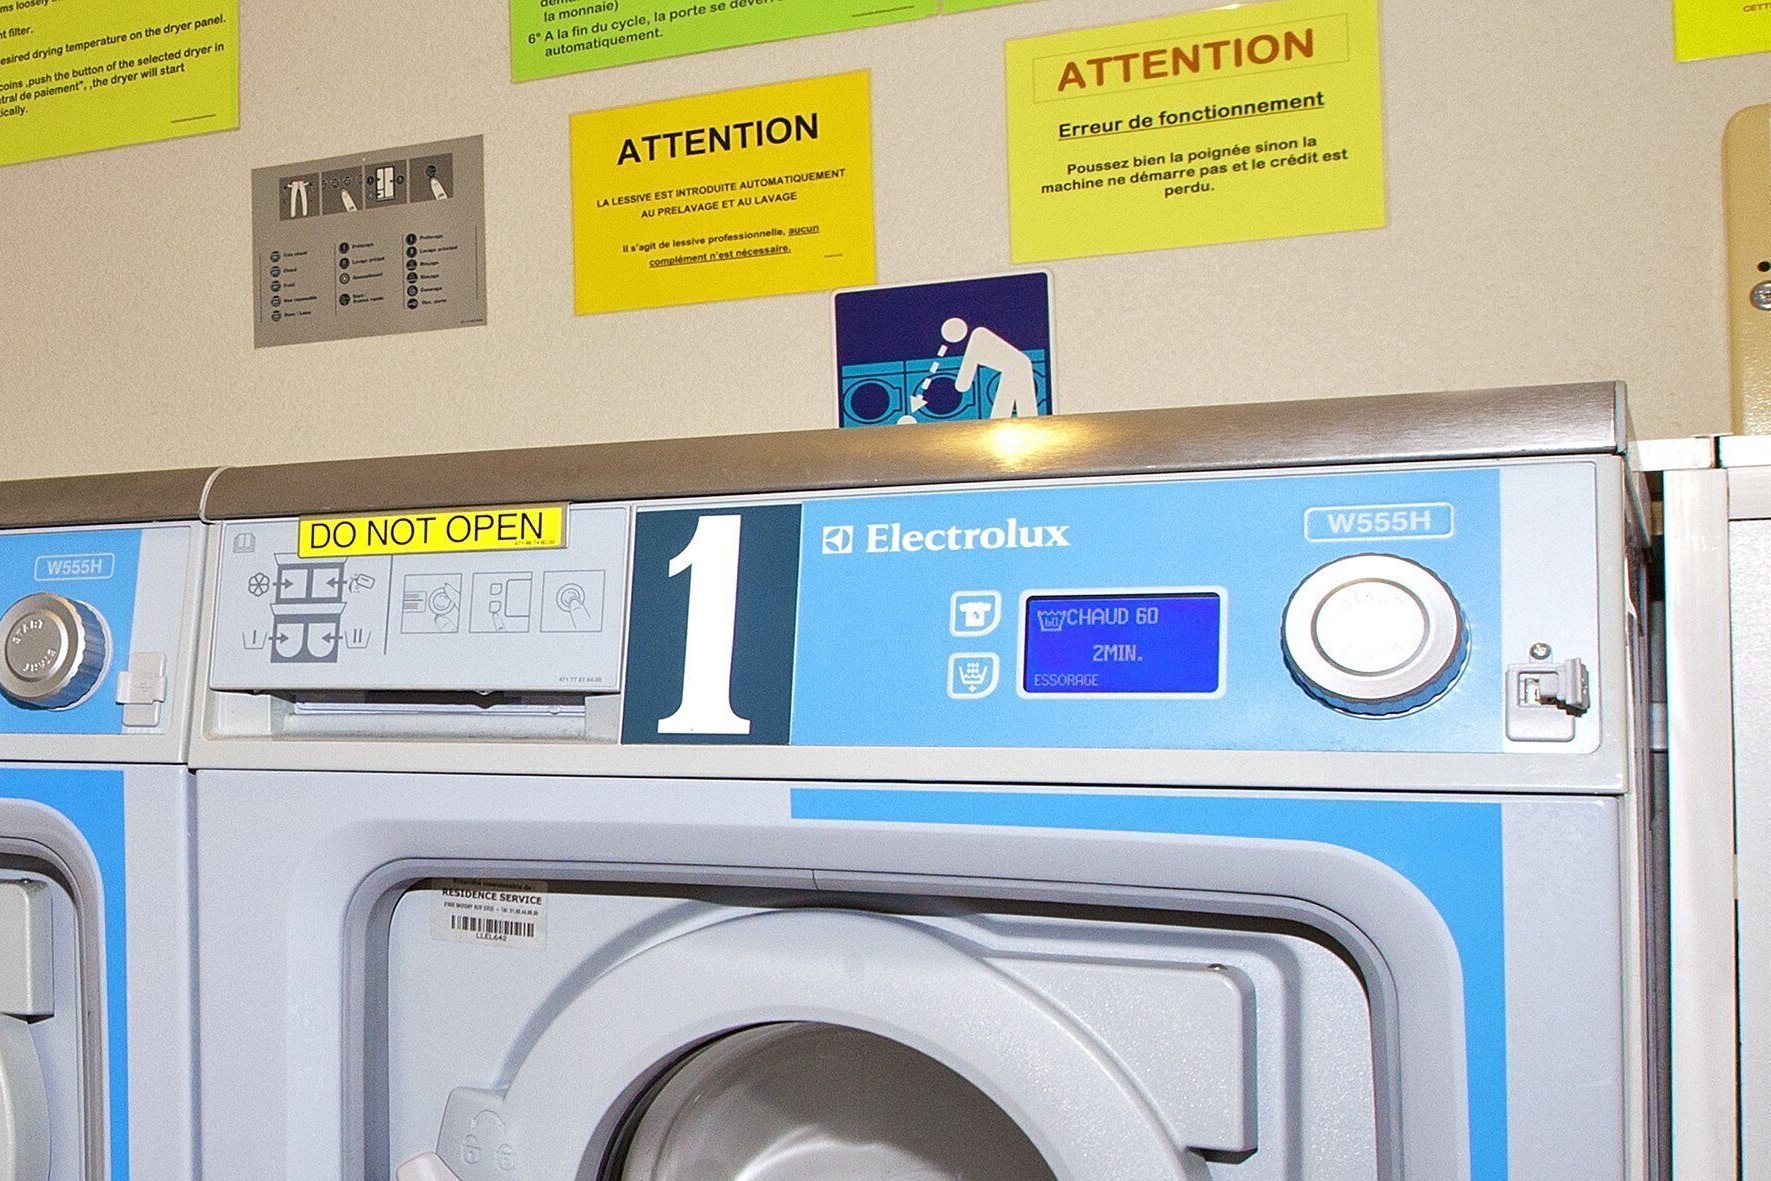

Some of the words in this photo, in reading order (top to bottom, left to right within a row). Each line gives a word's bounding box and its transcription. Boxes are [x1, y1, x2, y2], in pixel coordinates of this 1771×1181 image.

[544, 12, 555, 22] la
[559, 1, 619, 20] monnaie)
[545, 32, 554, 41] A
[557, 30, 569, 39] la
[572, 26, 588, 36] fin
[592, 23, 608, 33] du
[611, 15, 650, 31] cycle,
[654, 12, 665, 22] la
[669, 5, 706, 22] porte
[710, 2, 726, 12] se
[8, 26, 33, 37] filter.
[32, 46, 63, 59] drying
[65, 34, 127, 52] temperature
[129, 31, 142, 40] on
[144, 27, 161, 37] the
[163, 21, 192, 34] dryer
[194, 13, 226, 30] panel.
[545, 28, 663, 57] automatiquement.
[25, 73, 52, 88] ,push
[53, 71, 69, 81] the
[71, 65, 103, 77] button
[105, 60, 116, 71] of
[118, 59, 134, 69] the
[137, 49, 181, 66] selected
[183, 45, 212, 58] dryer
[214, 42, 224, 51] in
[1057, 28, 1313, 92] ATTENTION
[19, 86, 31, 100] de
[33, 80, 86, 100] paiement",
[89, 77, 108, 90] ,the
[110, 72, 138, 85] dryer
[140, 67, 157, 78] will
[159, 62, 184, 75] start
[1059, 120, 1123, 138] Erreur
[1128, 114, 1152, 129] de
[1158, 91, 1324, 125] fonctionnement
[617, 112, 817, 165] ATTENTION
[1041, 178, 1103, 193] machine
[1107, 176, 1125, 186] ne
[1129, 168, 1195, 183] démarre
[1199, 164, 1227, 178] pas
[1232, 160, 1248, 172] et
[1251, 158, 1265, 170] le
[1269, 152, 1318, 167] crédit
[1322, 148, 1348, 161] est
[1067, 159, 1129, 175] Poussez
[1133, 155, 1165, 167] bien
[1170, 152, 1183, 163] la
[1188, 144, 1250, 163] poignée
[1255, 140, 1298, 153] sinon
[1302, 136, 1316, 147] la
[596, 198, 609, 207] LA
[611, 192, 651, 205] LESSIVE
[654, 189, 673, 200] EST
[675, 182, 736, 197] INTRODUITE
[739, 168, 845, 189] AUTOMATIQUEMENT
[1164, 182, 1214, 198] perdu.
[640, 209, 655, 218] AU
[657, 201, 718, 216] PRELAVAGE
[721, 199, 734, 208] ET
[737, 197, 751, 206] AU
[754, 191, 796, 204] LAVAGE
[630, 242, 656, 252] s'agit
[658, 240, 670, 249] de
[672, 237, 705, 247] lessive
[707, 228, 785, 245] professionnelle,
[788, 225, 819, 235] aucun
[649, 253, 707, 267] complément
[736, 245, 790, 259] nécessaire.
[310, 519, 356, 549] DO
[367, 517, 436, 546] NOT
[447, 512, 544, 543] OPEN
[866, 518, 1071, 553] Electrolux
[1327, 510, 1432, 534] W555H
[47, 559, 103, 576] W555H
[657, 514, 751, 735] 1
[1067, 607, 1129, 626] CHAUD
[1136, 606, 1159, 625] 60
[1092, 644, 1143, 662] 2MIN.
[1034, 673, 1099, 687] ESSORAGE
[442, 888, 497, 901] RESIDENCE
[499, 892, 542, 906] SERVICE
